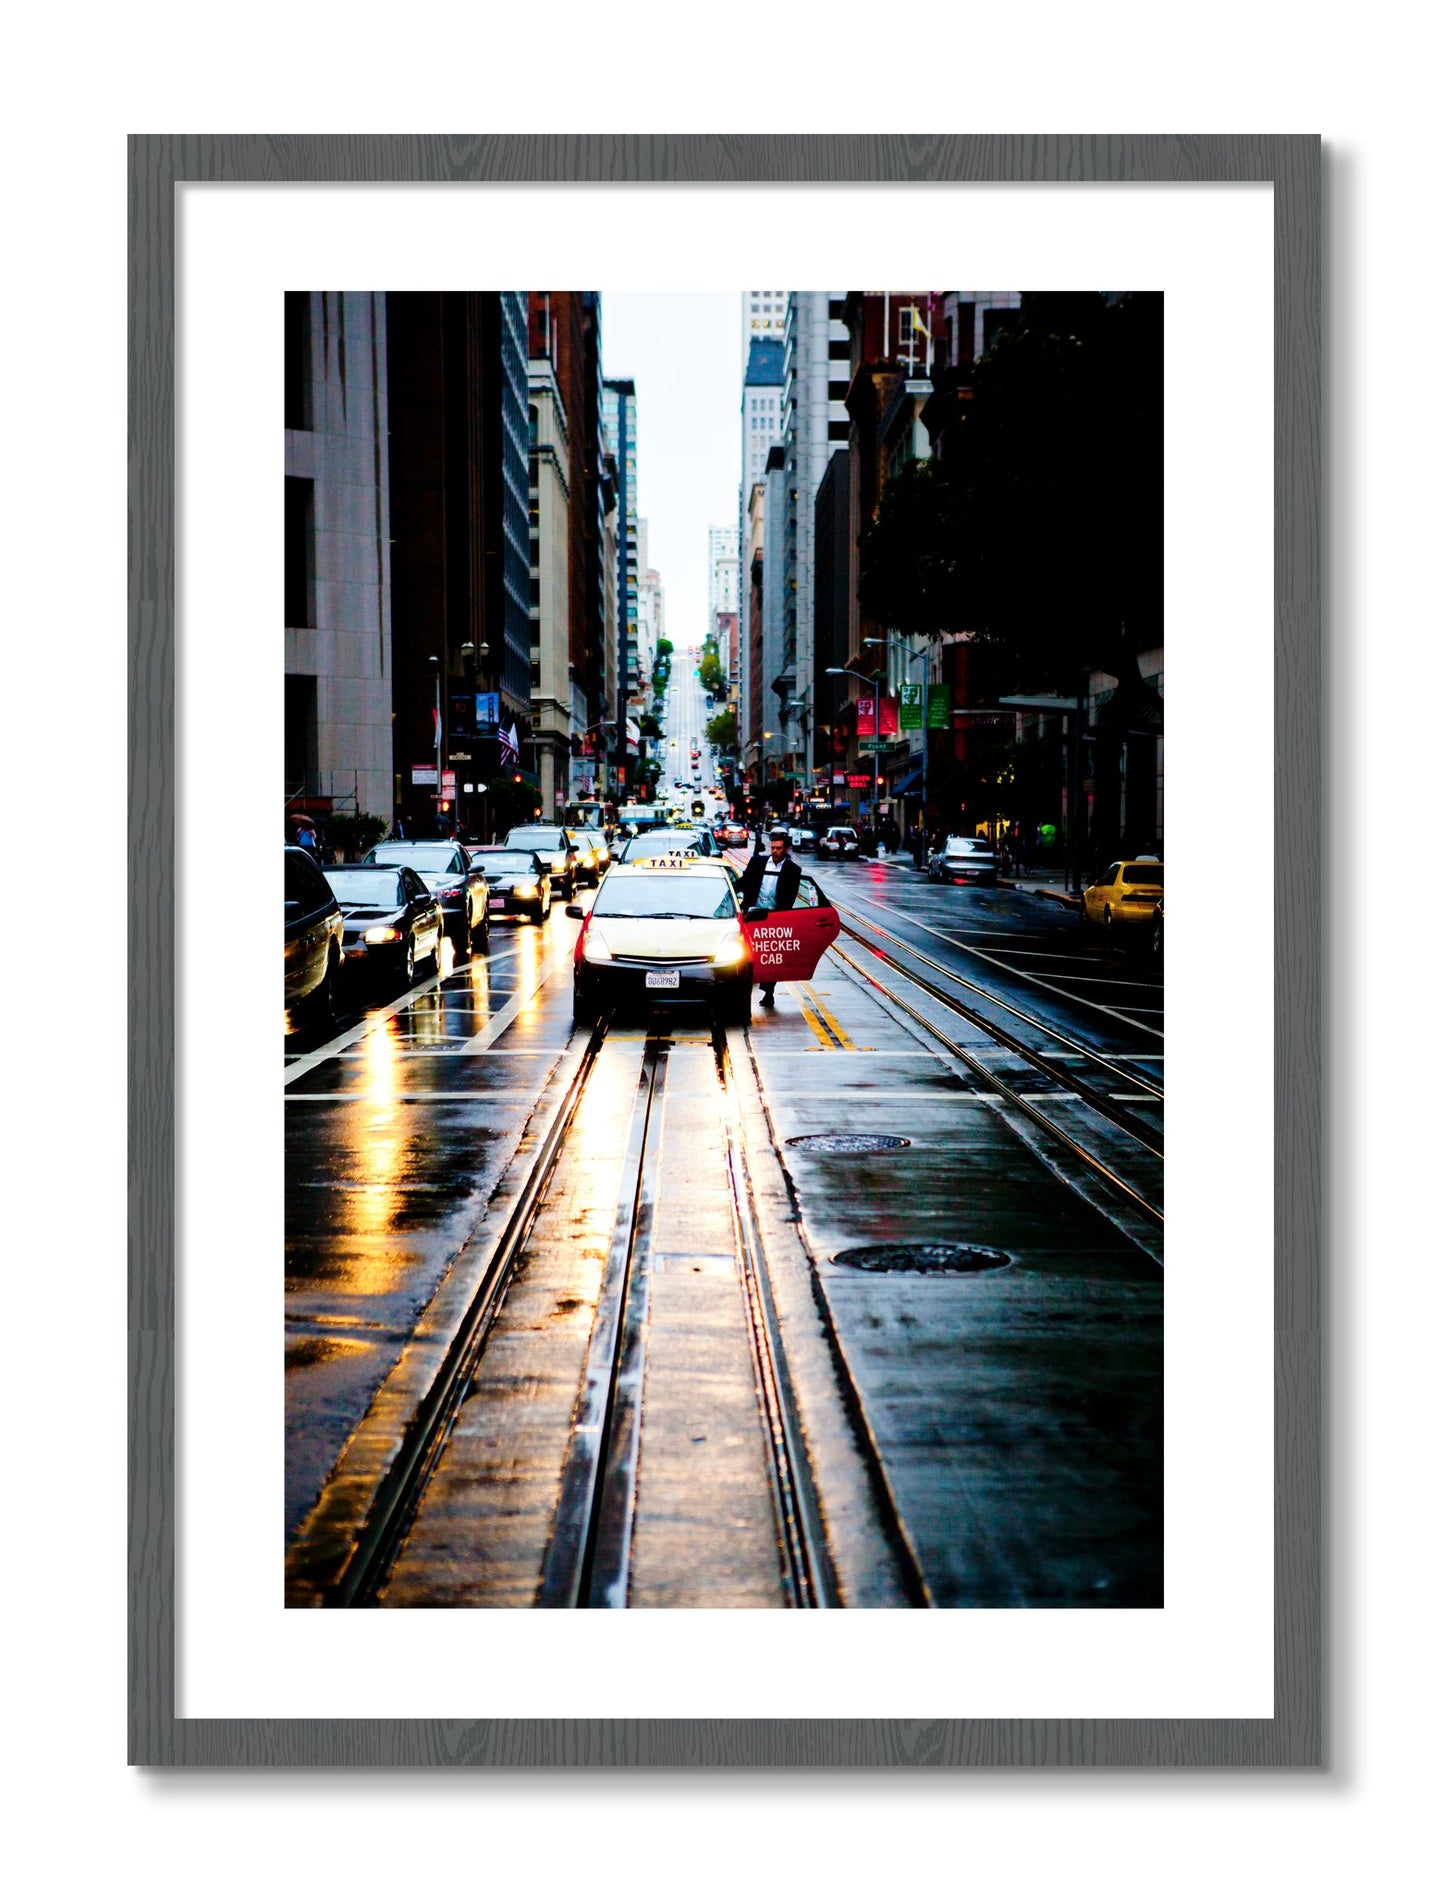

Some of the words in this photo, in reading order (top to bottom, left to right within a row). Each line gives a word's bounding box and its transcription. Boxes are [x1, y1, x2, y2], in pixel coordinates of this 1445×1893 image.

[650, 859, 682, 868] TAXI
[753, 927, 793, 939] ARROW
[760, 953, 783, 965] CAB
